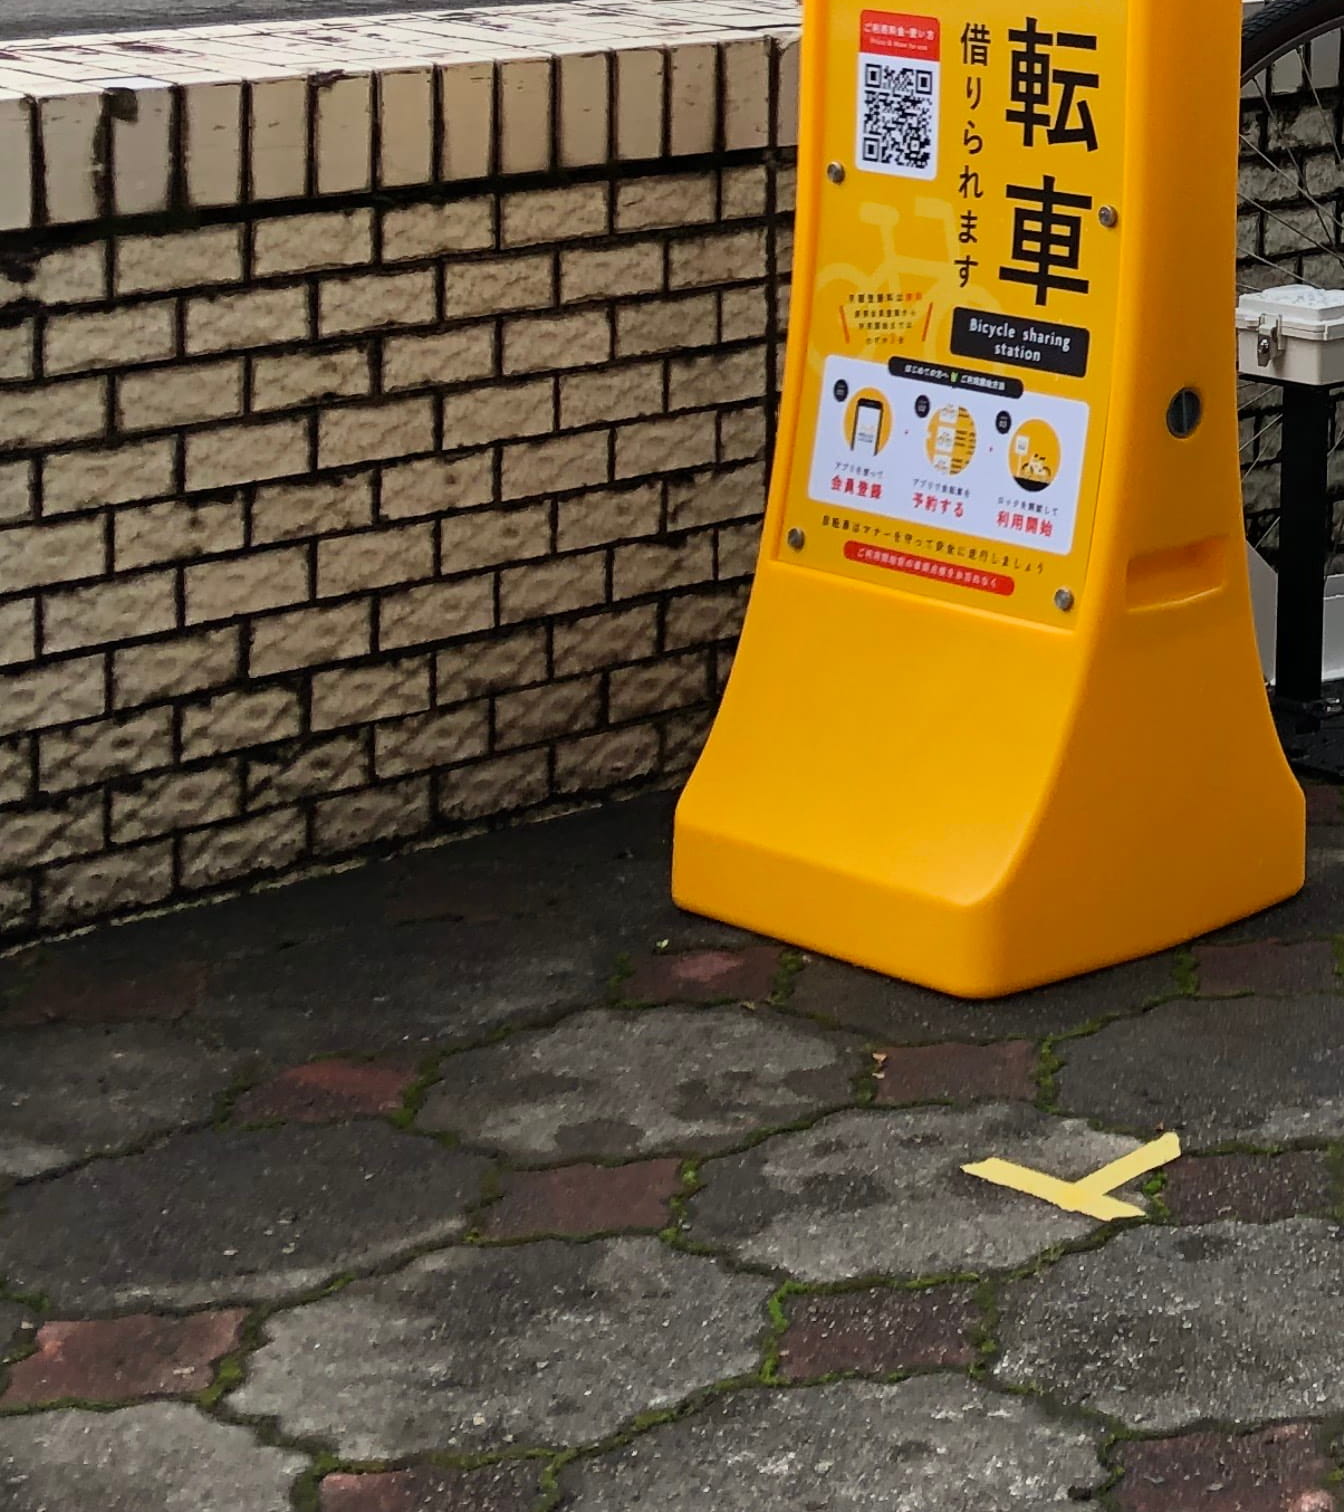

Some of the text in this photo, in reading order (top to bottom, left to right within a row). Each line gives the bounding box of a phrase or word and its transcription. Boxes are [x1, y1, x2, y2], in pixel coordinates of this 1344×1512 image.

[953, 22, 991, 289] 借りられます
[969, 317, 1072, 353] Bicycle sharing
[994, 343, 1041, 362] station
[831, 474, 883, 500] 会員登録
[911, 492, 966, 519] 予約する
[996, 510, 1055, 538] 利用開始
